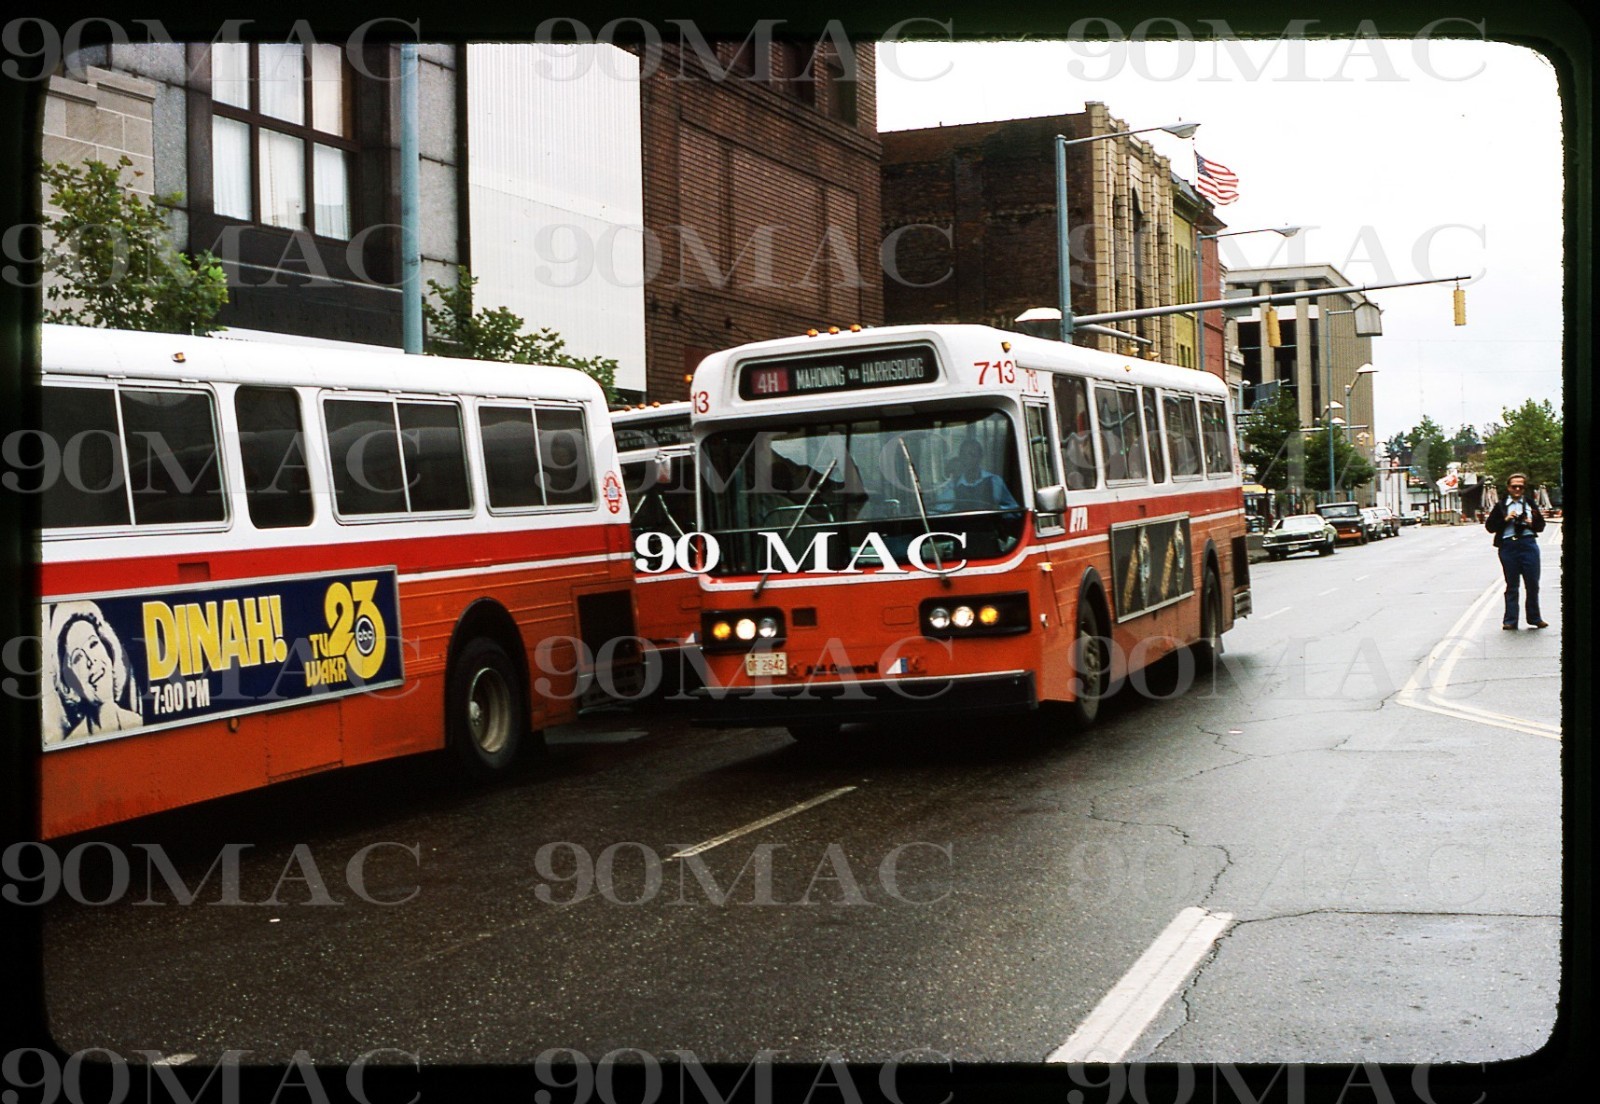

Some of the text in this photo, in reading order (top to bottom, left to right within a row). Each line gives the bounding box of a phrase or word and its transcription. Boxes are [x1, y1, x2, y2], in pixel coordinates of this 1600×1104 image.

[756, 371, 779, 393] 4H
[796, 365, 846, 391] MAHONING
[861, 357, 924, 384] HARRISBURG
[974, 360, 1015, 385] 713
[143, 595, 288, 681] DINAH!
[324, 579, 387, 679] 23
[358, 631, 373, 642] abc
[305, 656, 348, 687] WAKR
[151, 678, 211, 715] 7:00 PM
